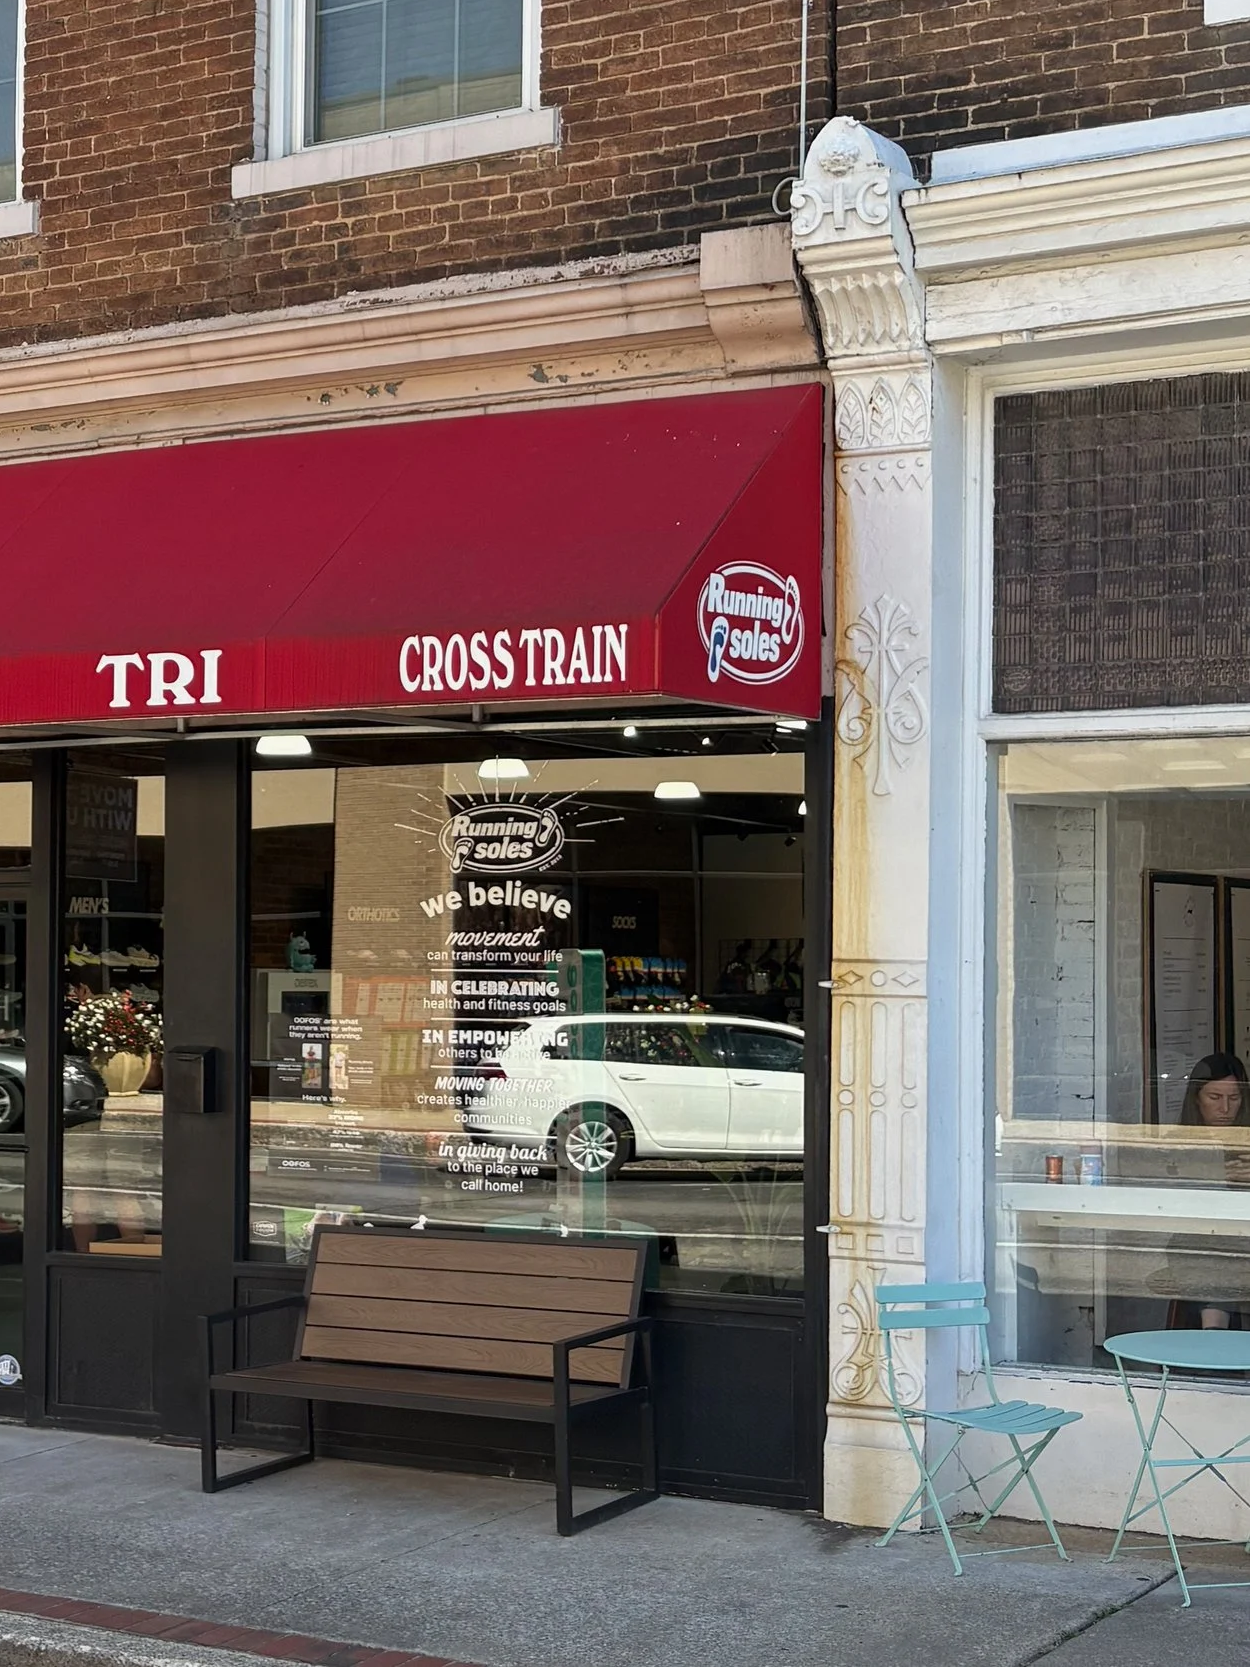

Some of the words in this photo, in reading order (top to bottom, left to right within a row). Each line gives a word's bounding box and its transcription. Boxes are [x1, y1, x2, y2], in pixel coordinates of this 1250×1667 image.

[707, 572, 784, 628] Running
[729, 620, 781, 663] soles
[399, 628, 515, 692] CROSS
[519, 624, 629, 687] TRAIN
[95, 649, 223, 708] TRI
[452, 815, 539, 839] Running
[474, 836, 533, 859] soles
[69, 896, 110, 914] MEN'S
[419, 889, 462, 919] we
[468, 880, 572, 919] believe
[445, 925, 546, 947] movement
[427, 950, 448, 961] can
[451, 949, 512, 962] transform
[513, 951, 540, 964] your
[543, 949, 563, 962] life
[430, 980, 448, 995] IN
[450, 980, 560, 997] CELEBRATING
[423, 997, 461, 1010] health
[462, 998, 486, 1010] and
[488, 998, 531, 1011] fitness
[532, 999, 566, 1014] goals
[422, 1029, 444, 1044] IN
[438, 1048, 478, 1059] others
[479, 1048, 493, 1060] to
[434, 1076, 485, 1091] MOVING
[488, 1077, 554, 1092] TOGETHER
[417, 1094, 463, 1105] creates
[525, 1096, 571, 1110] happier
[454, 1112, 533, 1126] communities
[438, 1142, 453, 1157] in
[457, 1142, 506, 1164] giving
[510, 1143, 548, 1161] back
[447, 1161, 461, 1172] to
[462, 1161, 483, 1173] the
[485, 1162, 519, 1176] place
[520, 1165, 539, 1176] we
[461, 1178, 482, 1190] call
[484, 1179, 524, 1193] home!
